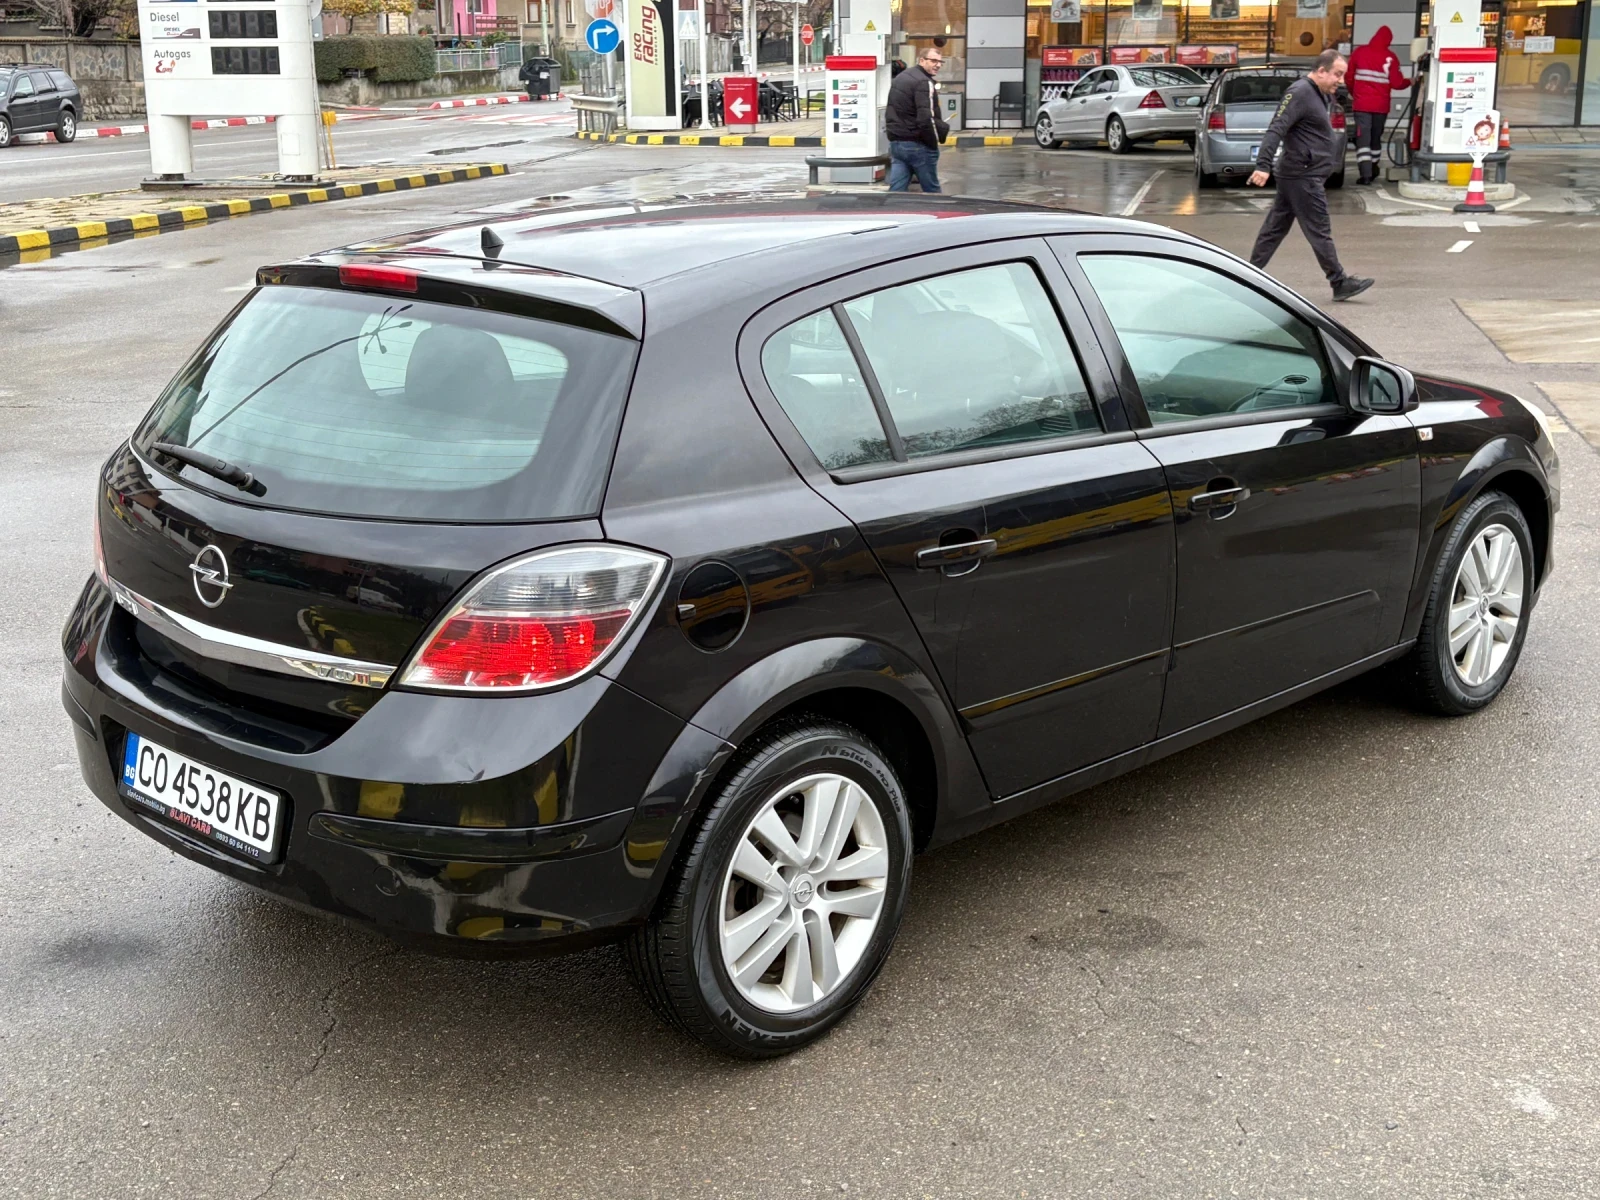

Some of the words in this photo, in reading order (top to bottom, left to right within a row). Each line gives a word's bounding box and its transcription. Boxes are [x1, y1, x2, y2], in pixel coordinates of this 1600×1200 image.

[150, 12, 180, 22] Diesel
[633, 32, 642, 61] EKO
[642, 5, 656, 65] racing
[154, 50, 191, 60] Autogas
[125, 764, 135, 779] BG
[821, 745, 840, 757] N
[839, 749, 873, 769] blue
[889, 787, 901, 813] Plus
[138, 745, 168, 794] CO
[172, 762, 231, 824] 4538
[235, 787, 271, 842] KB
[169, 807, 191, 827] SLAVI
[190, 817, 212, 836] CARS
[719, 1007, 806, 1046] NEXEN
